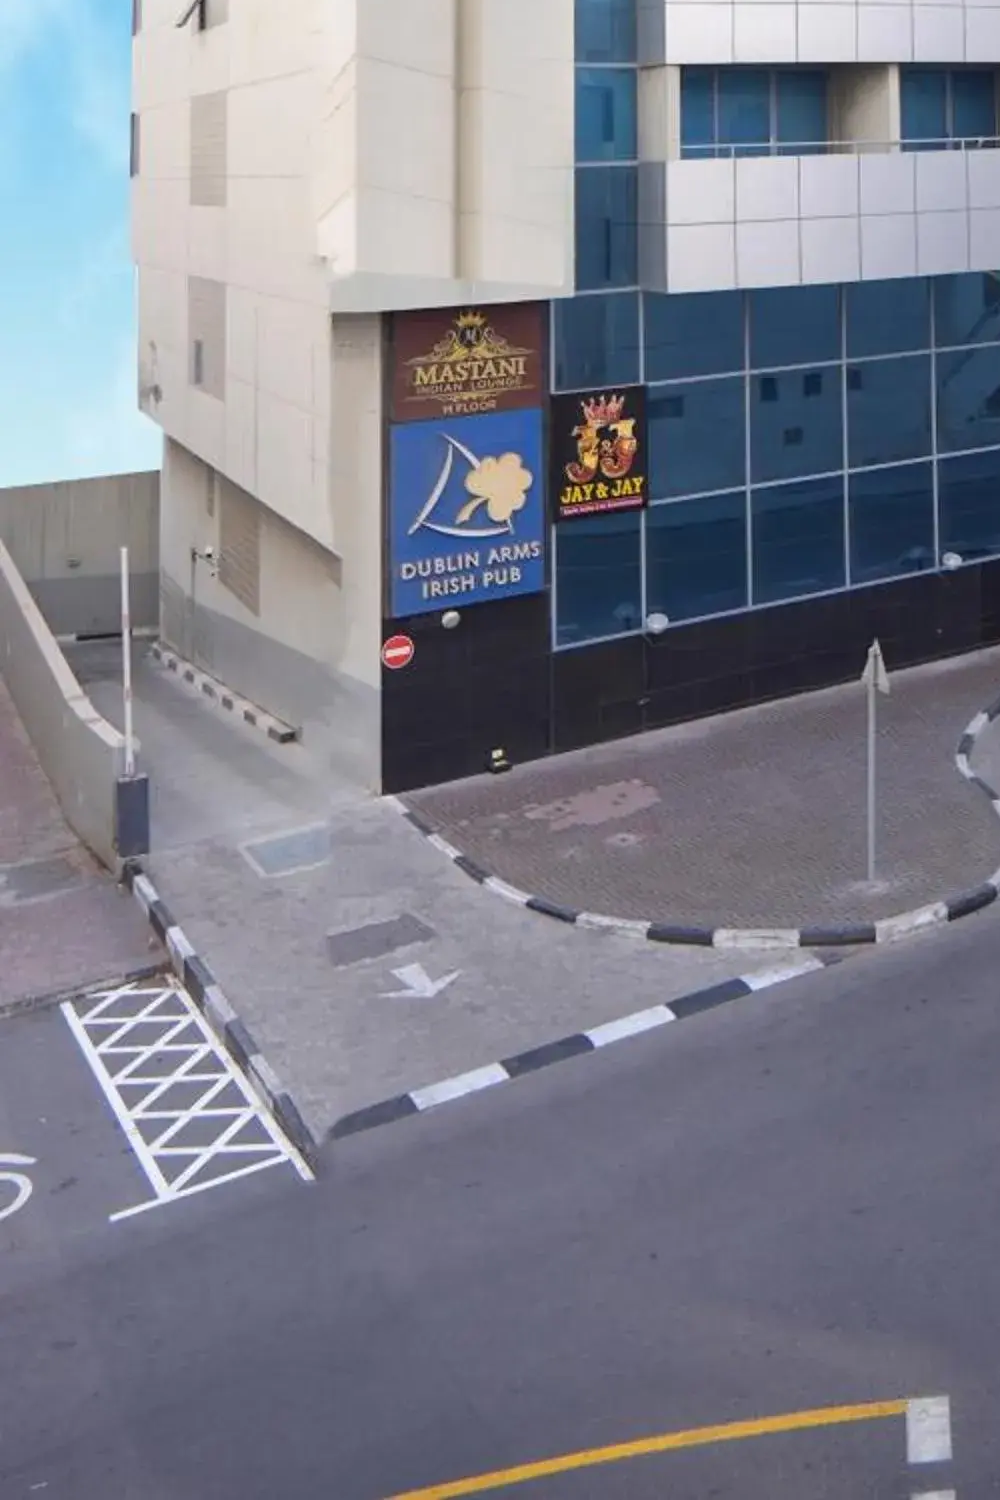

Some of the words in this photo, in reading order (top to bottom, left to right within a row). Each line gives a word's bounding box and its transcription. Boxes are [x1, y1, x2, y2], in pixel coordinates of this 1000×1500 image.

[414, 356, 527, 386] MASTANI
[416, 382, 463, 396] INDIAN
[471, 376, 523, 392] LOUNGE
[455, 399, 497, 413] FLOOR
[560, 482, 595, 504] JAY
[595, 481, 609, 499] &
[611, 476, 644, 498] JAY
[402, 551, 480, 580] DUBLIN
[488, 541, 542, 565] ARMS
[422, 574, 475, 599] IRISH
[483, 566, 522, 586] PUB
